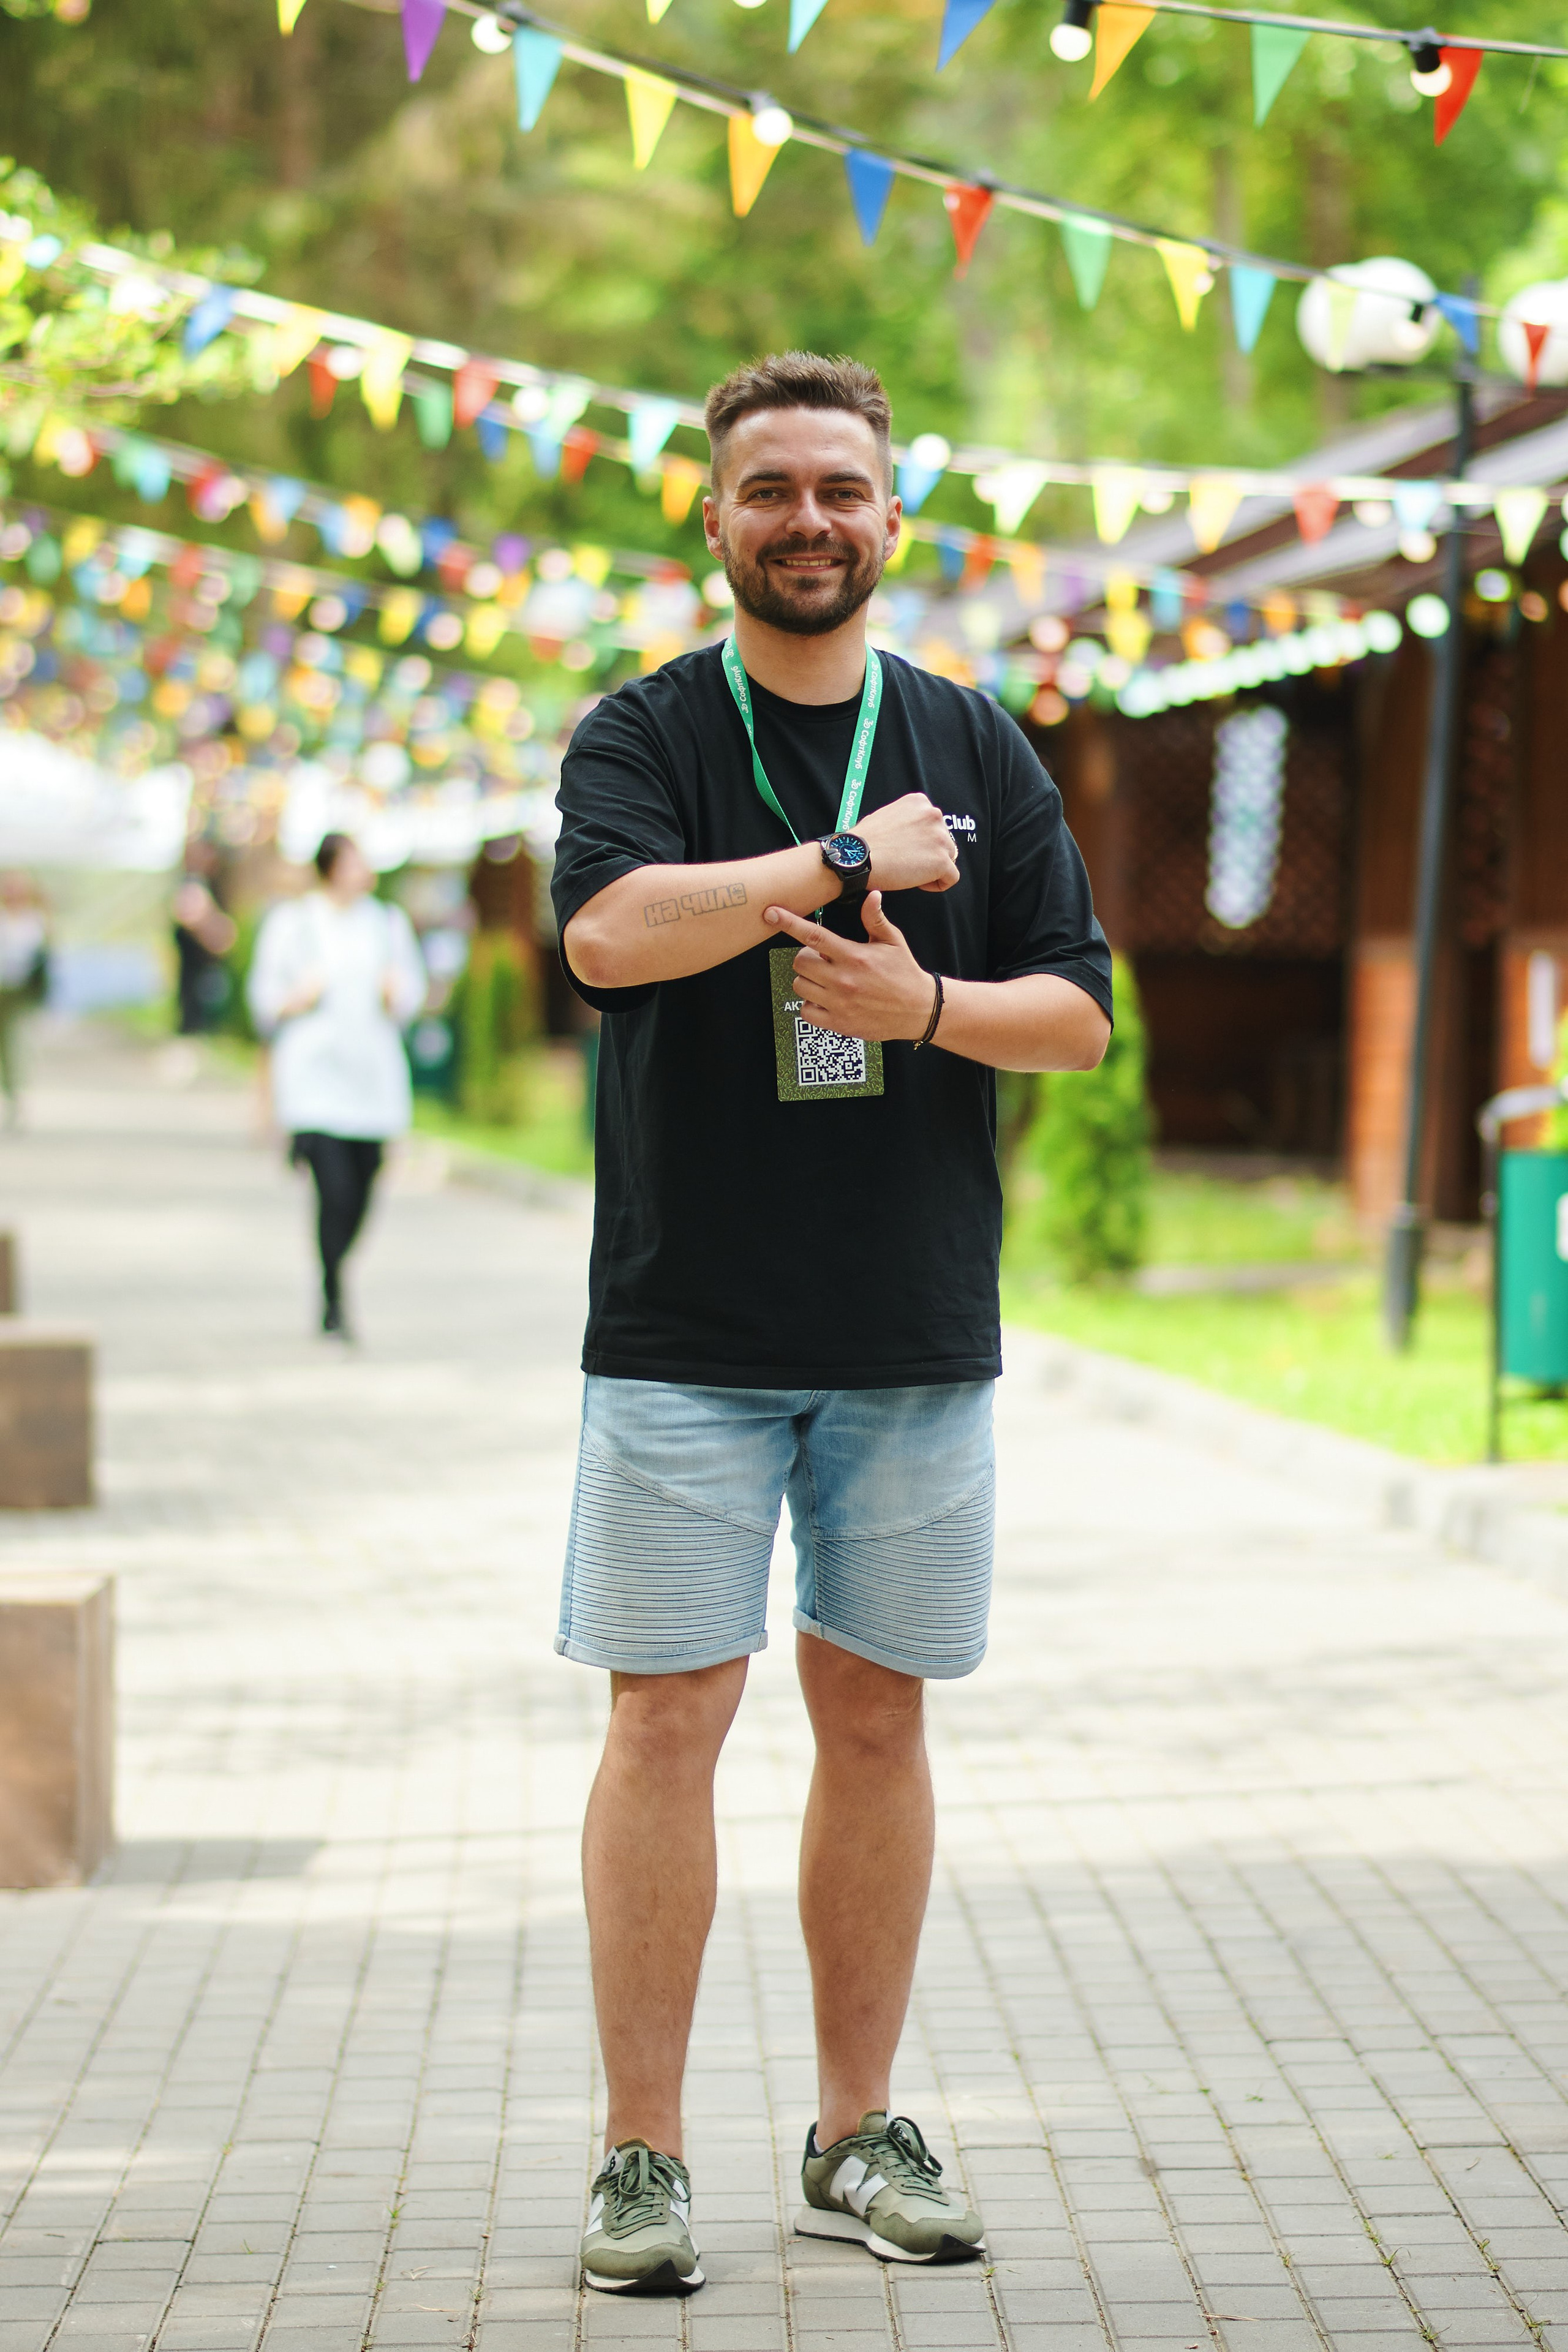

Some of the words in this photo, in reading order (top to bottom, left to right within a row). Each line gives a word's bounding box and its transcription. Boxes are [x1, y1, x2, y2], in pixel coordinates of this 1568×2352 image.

[730, 666, 747, 702] СофтКлуб
[867, 671, 878, 709] СофтКлуб
[854, 729, 869, 770] СофтКлуб
[842, 791, 857, 831] СофтКлуб
[943, 814, 976, 831] Club
